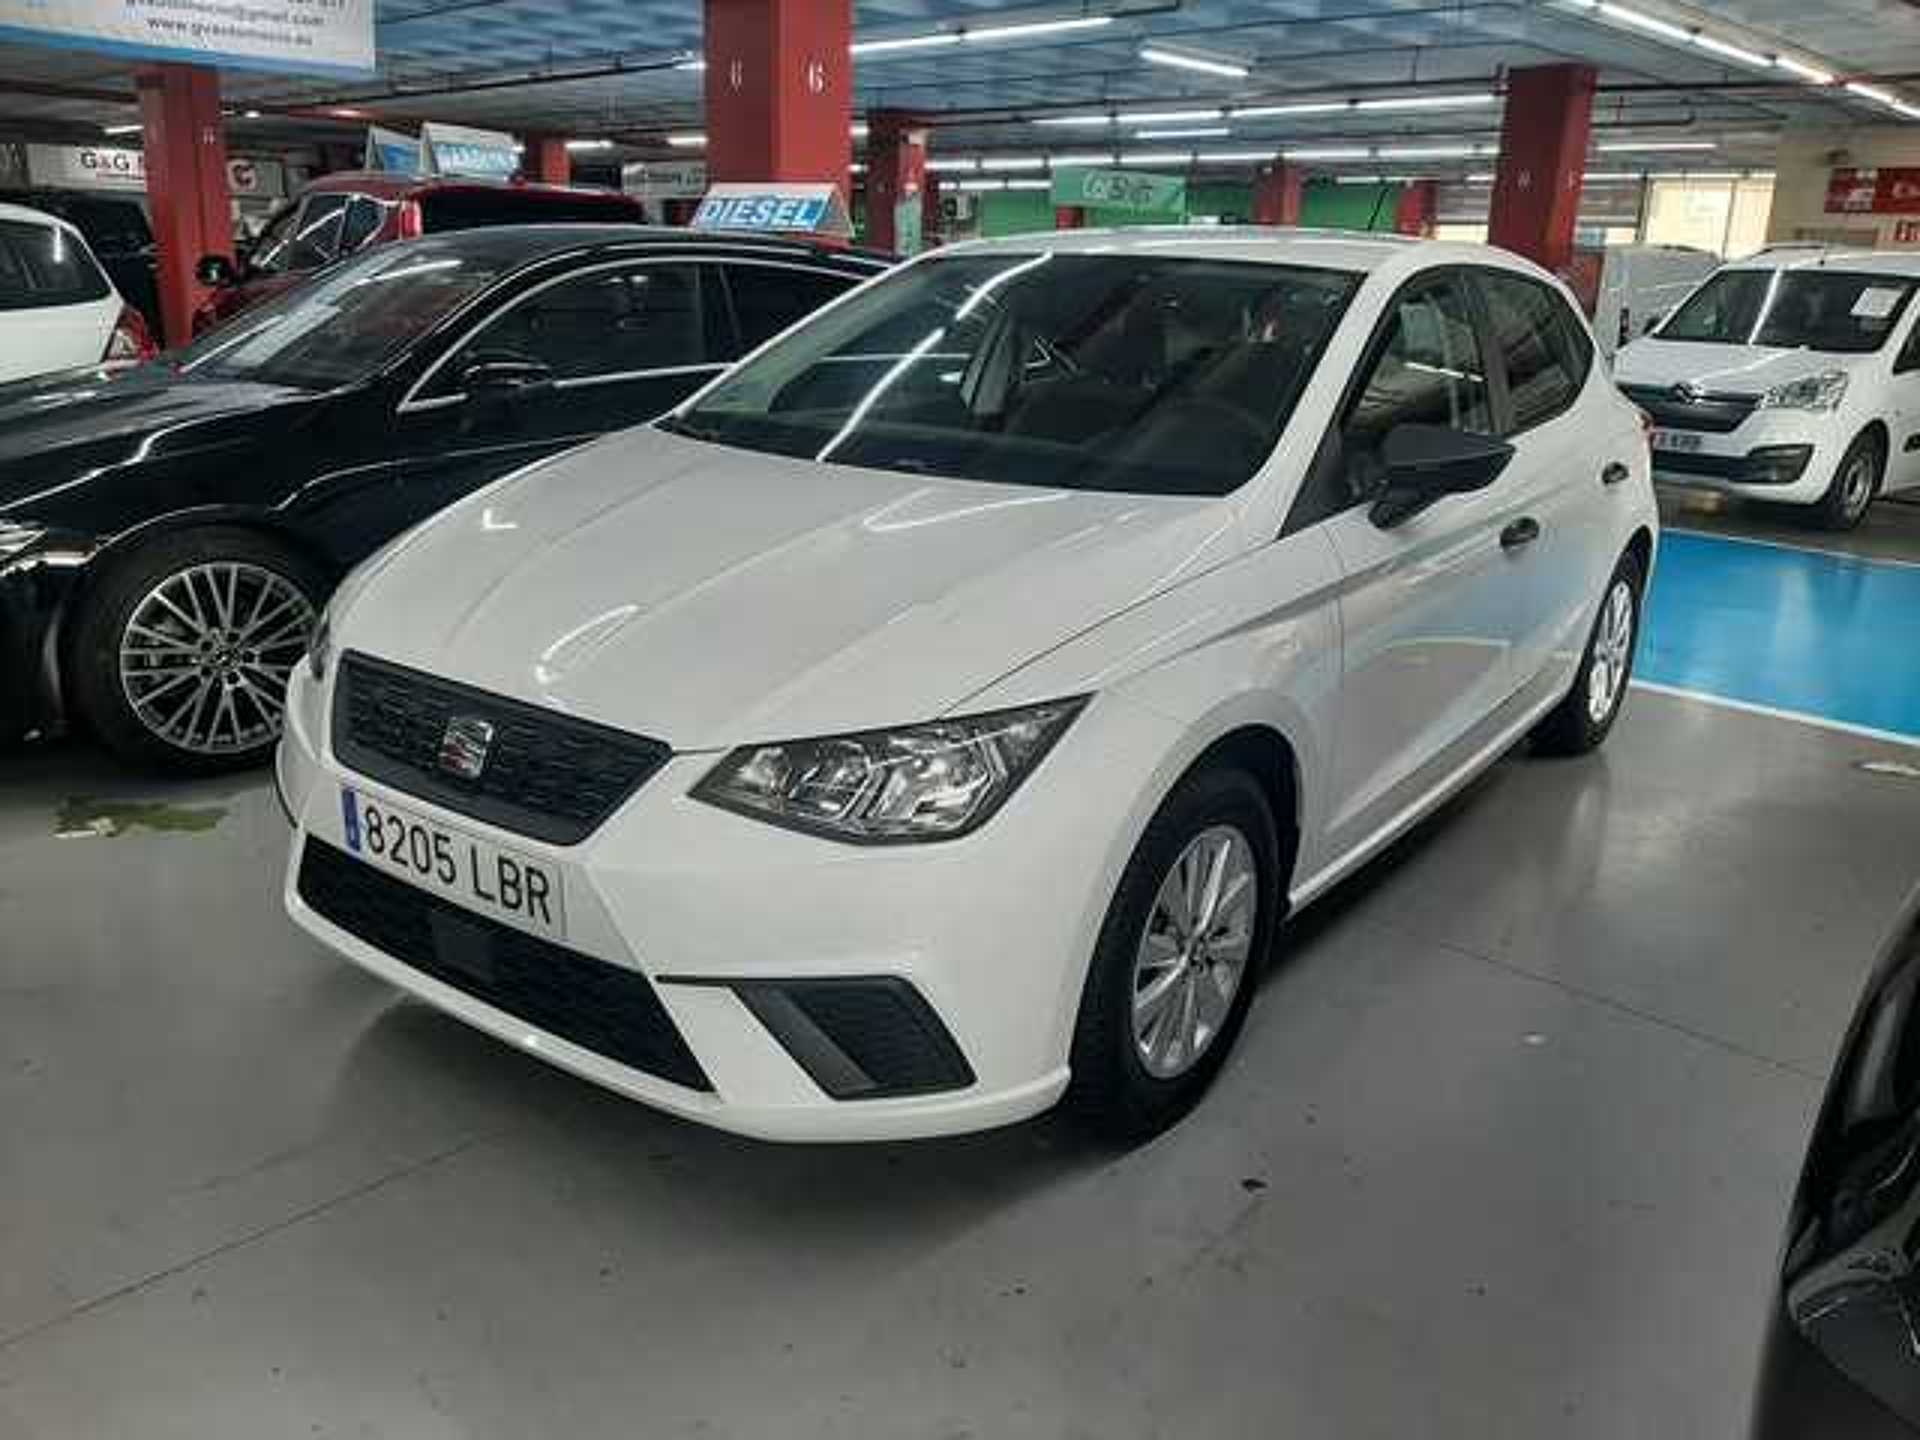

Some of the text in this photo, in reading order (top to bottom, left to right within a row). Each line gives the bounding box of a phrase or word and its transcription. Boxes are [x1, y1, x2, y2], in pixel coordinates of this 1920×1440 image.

[700, 197, 823, 229] DIESEL
[365, 805, 551, 925] 8205 LBR
